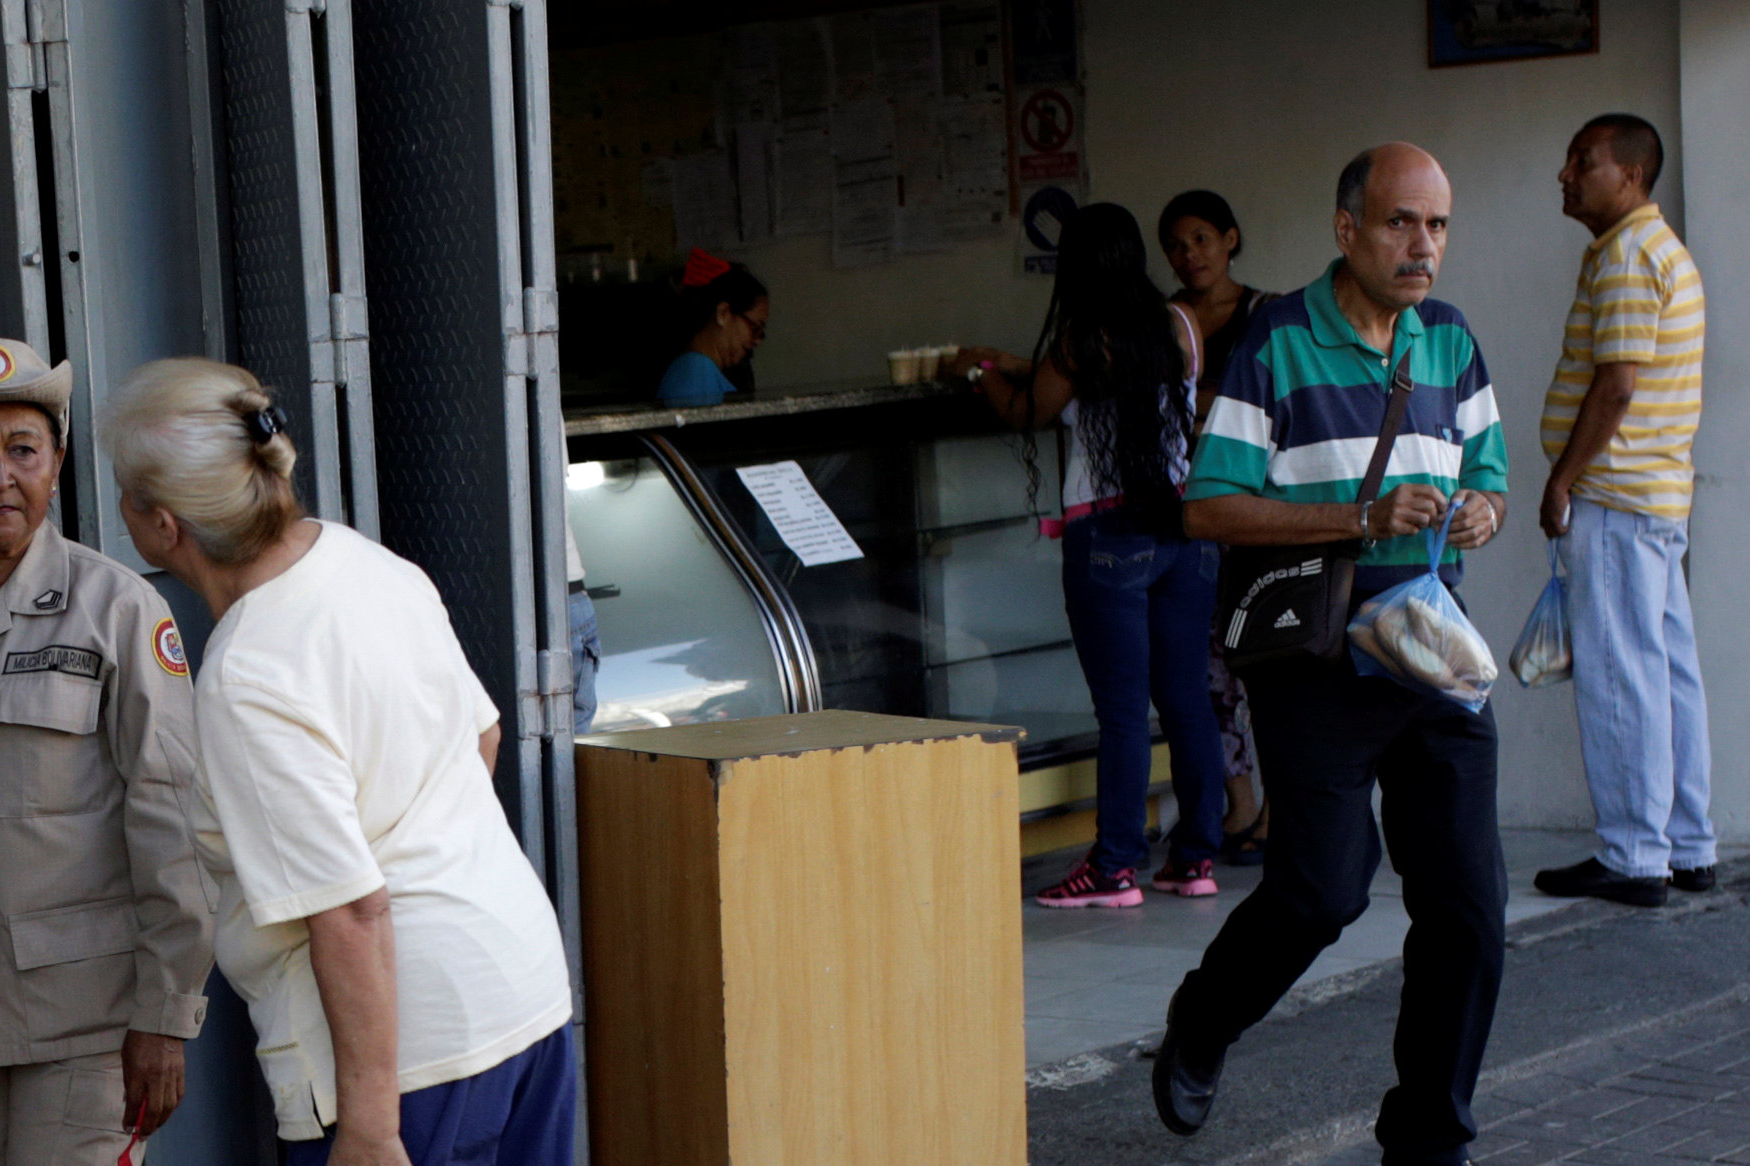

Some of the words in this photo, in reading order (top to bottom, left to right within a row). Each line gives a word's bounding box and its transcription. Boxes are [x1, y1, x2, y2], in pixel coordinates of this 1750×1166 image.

[1239, 565, 1301, 609] adidas
[1273, 618, 1301, 629] adidas
[41, 649, 92, 672] BOLIVARIANA
